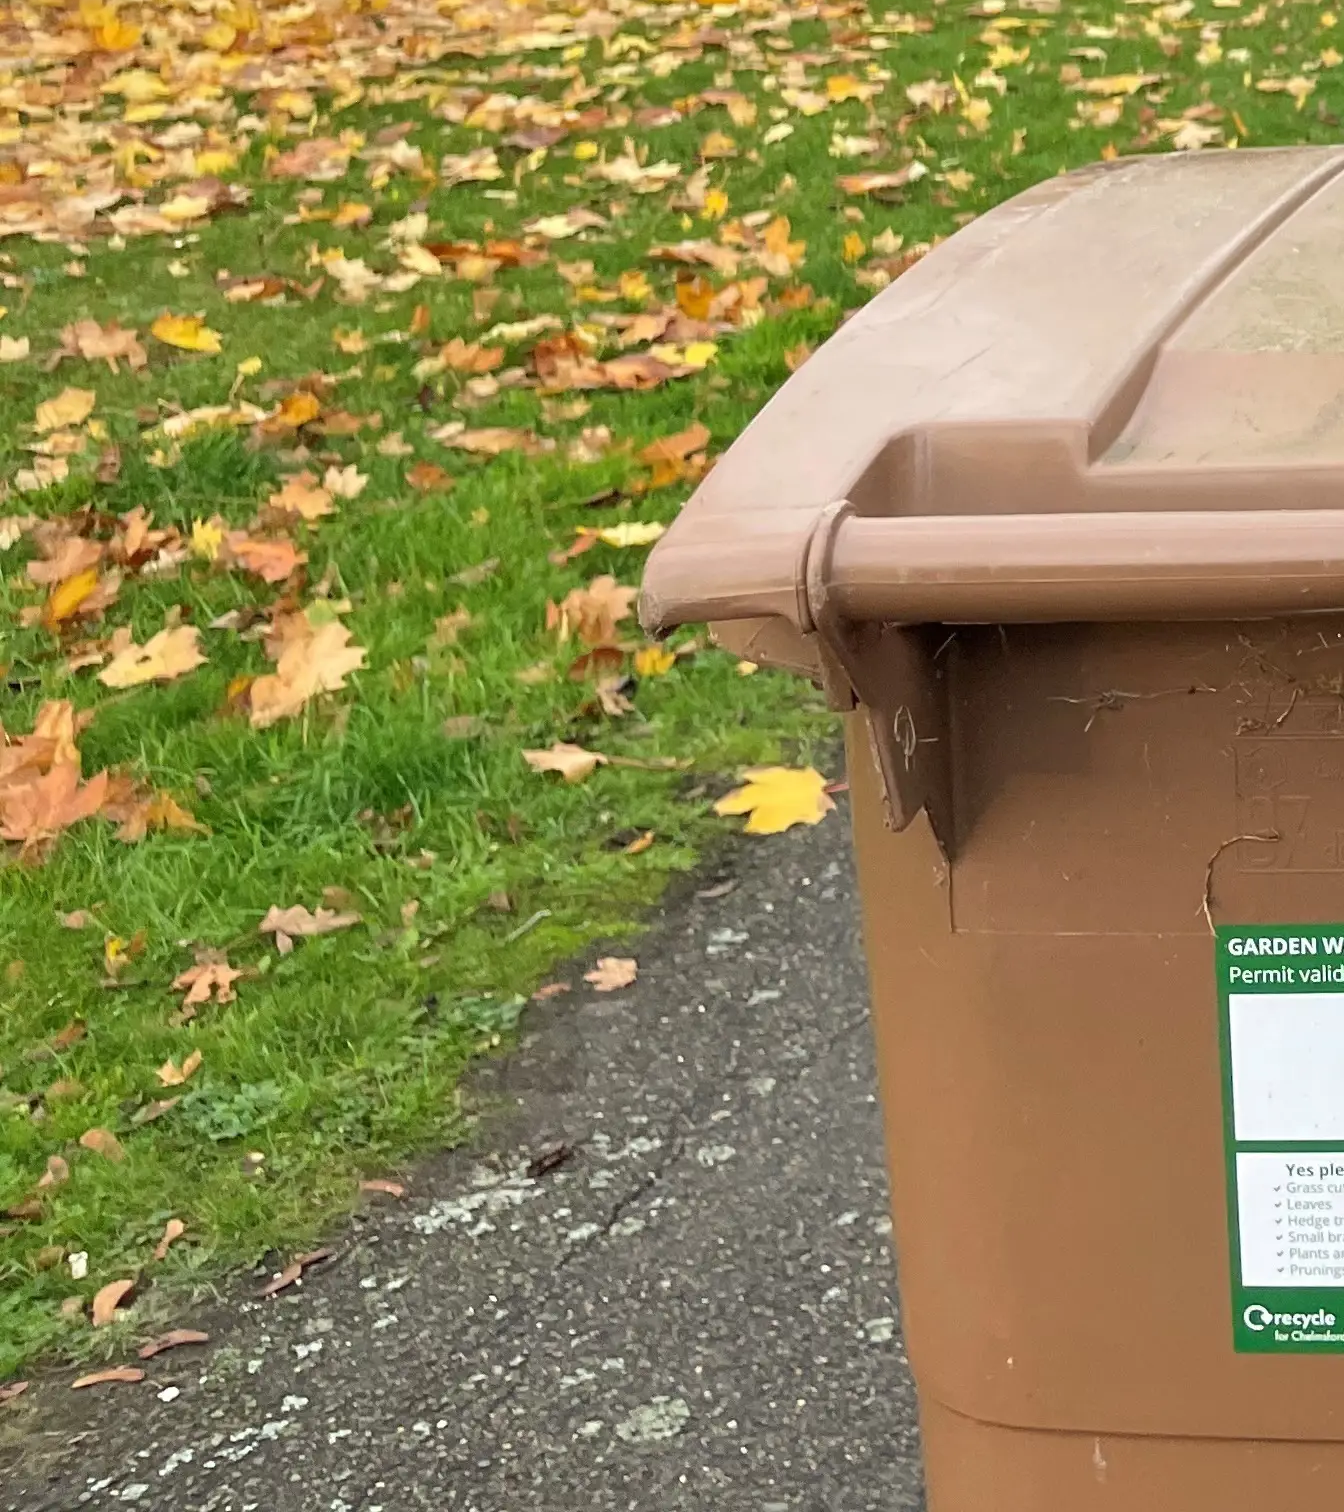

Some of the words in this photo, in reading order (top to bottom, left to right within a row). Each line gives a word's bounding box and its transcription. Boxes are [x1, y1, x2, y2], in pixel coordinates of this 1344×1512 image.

[1228, 937, 1317, 956] GARDEN
[1229, 965, 1295, 984] Permit
[1299, 964, 1344, 983] valid
[1286, 1163, 1314, 1177] Yes
[1286, 1182, 1324, 1194] Grass
[1287, 1199, 1333, 1211] Leaves
[1288, 1215, 1330, 1229] Hedge
[1288, 1231, 1324, 1243] Small
[1289, 1248, 1330, 1259] Plants
[1274, 1308, 1336, 1329] recycle
[1274, 1330, 1289, 1341] for
